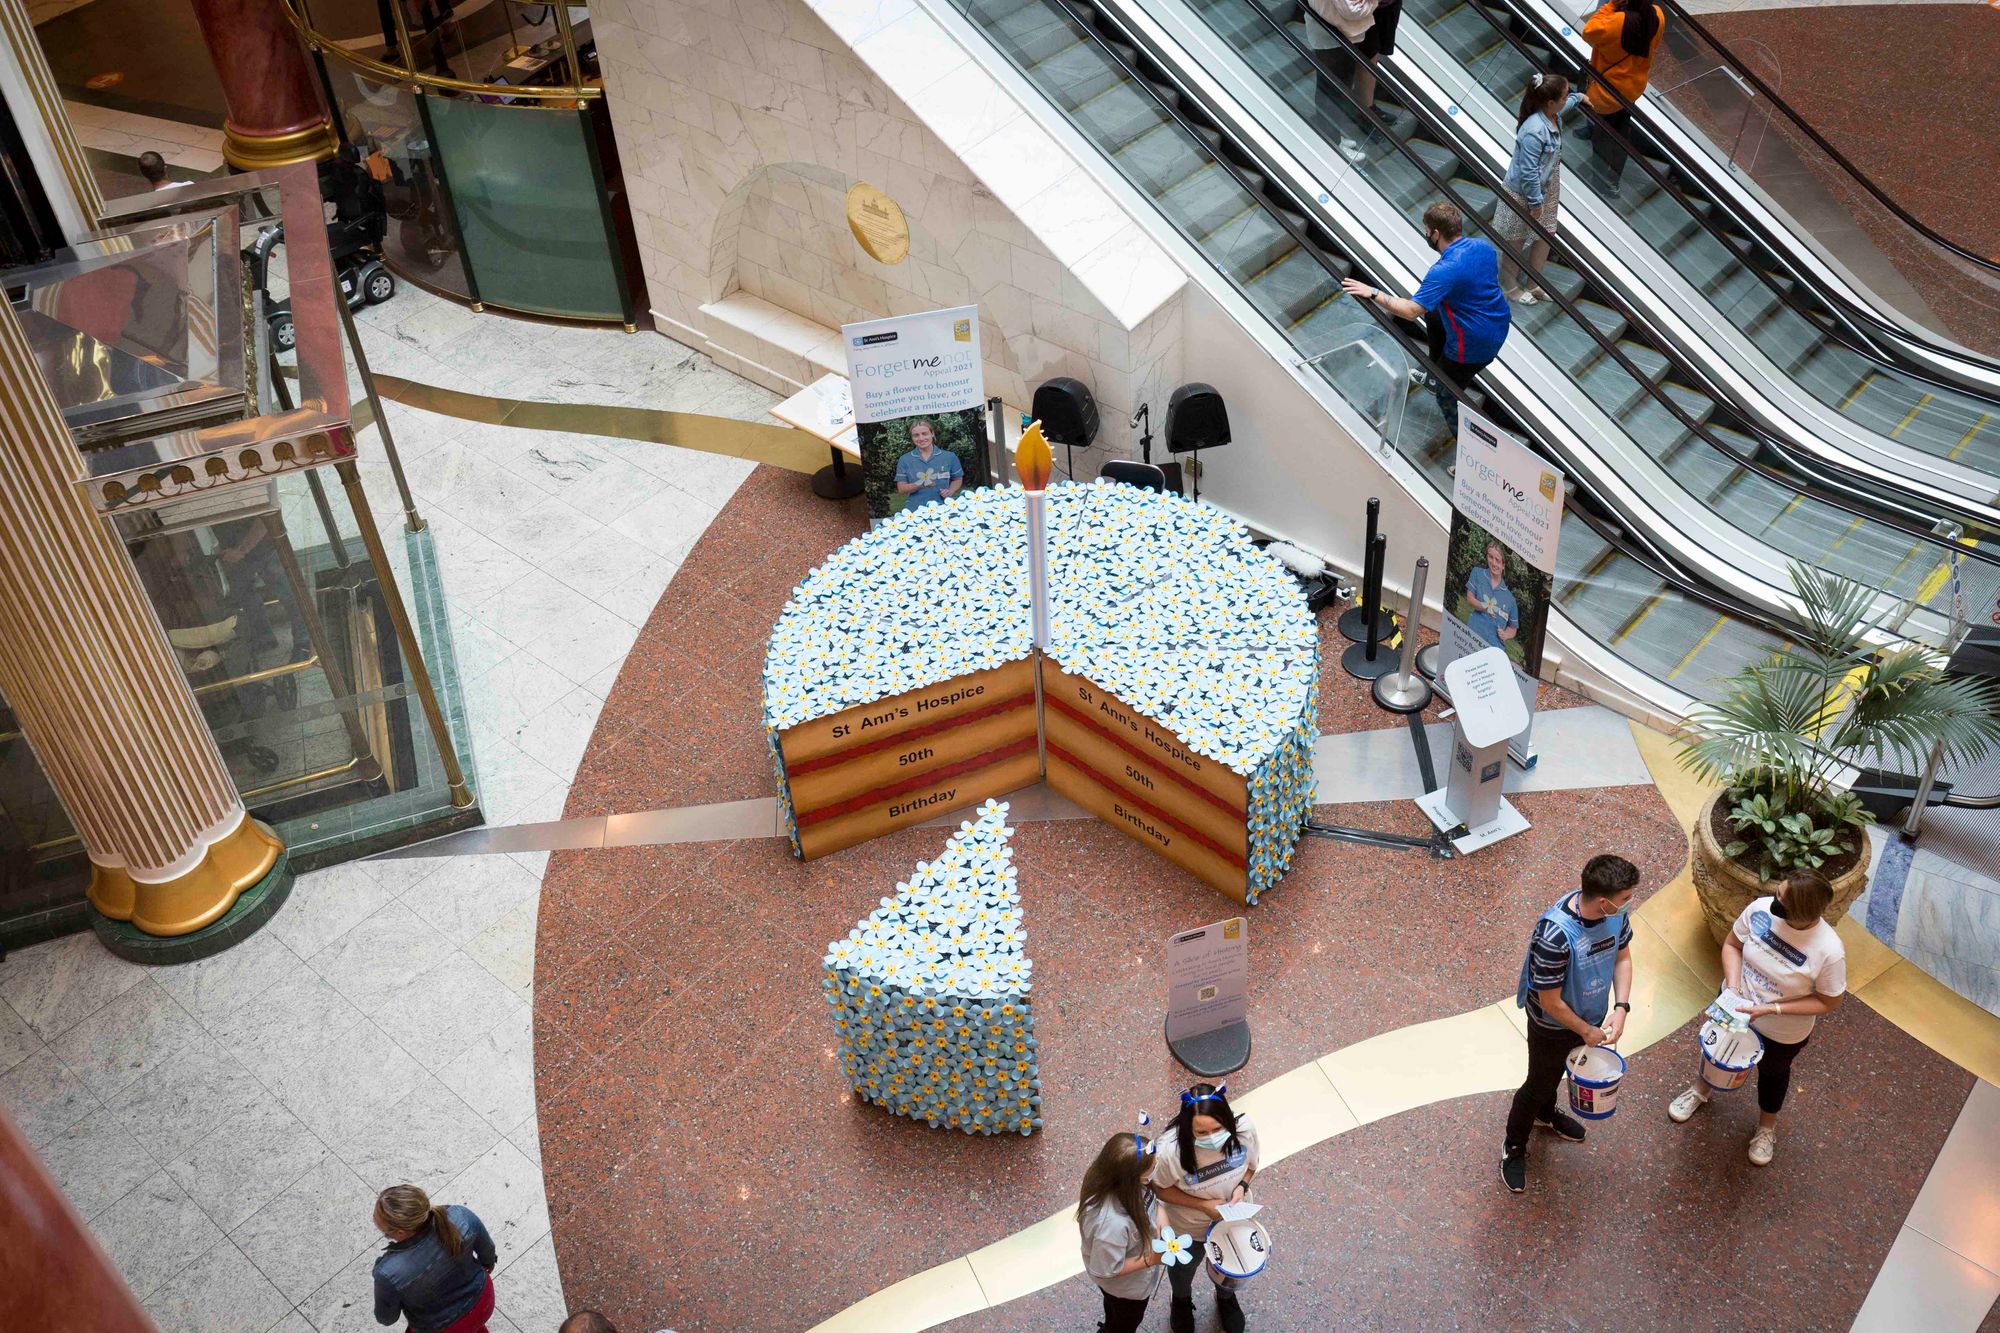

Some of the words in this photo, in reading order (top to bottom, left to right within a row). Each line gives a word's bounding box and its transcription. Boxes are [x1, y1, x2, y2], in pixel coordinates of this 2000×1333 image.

[855, 359, 909, 378] Forget
[912, 355, 941, 369] me
[943, 350, 971, 364] not
[923, 367, 952, 377] Appeal
[953, 362, 973, 373] 2021
[864, 397, 906, 409] someone
[908, 394, 926, 404] you
[928, 390, 949, 401] love,
[951, 389, 961, 397] or
[963, 386, 973, 395] to
[865, 389, 883, 401] Buy
[892, 385, 921, 396] flower
[924, 382, 934, 391] to
[936, 378, 970, 389] honour
[870, 405, 912, 418] celebrate
[922, 398, 970, 411] milestone.
[1460, 445, 1500, 487] Forget
[1502, 479, 1525, 502] me
[1525, 497, 1551, 522] not
[1459, 490, 1491, 516] someone
[1492, 511, 1506, 527] you
[1525, 538, 1533, 550] or
[1535, 543, 1544, 554] to
[1460, 502, 1494, 529] celebrate
[1461, 479, 1475, 494] Buy
[1482, 493, 1505, 515] flower
[1506, 511, 1514, 522] to
[1515, 518, 1543, 543] honour
[1508, 498, 1531, 517] Appeal
[1532, 514, 1550, 530] 2021
[832, 724, 851, 739] St
[860, 707, 909, 730] Ann's
[916, 684, 985, 713] Hospice
[1079, 687, 1093, 705] St
[1100, 701, 1138, 732] Ann's
[1145, 727, 1201, 772] Hospice
[899, 747, 934, 767] 50th
[1125, 765, 1154, 791] 50th
[888, 788, 957, 818] Birthday
[1114, 803, 1171, 847] Birthday
[1782, 946, 1804, 963] Hospice
